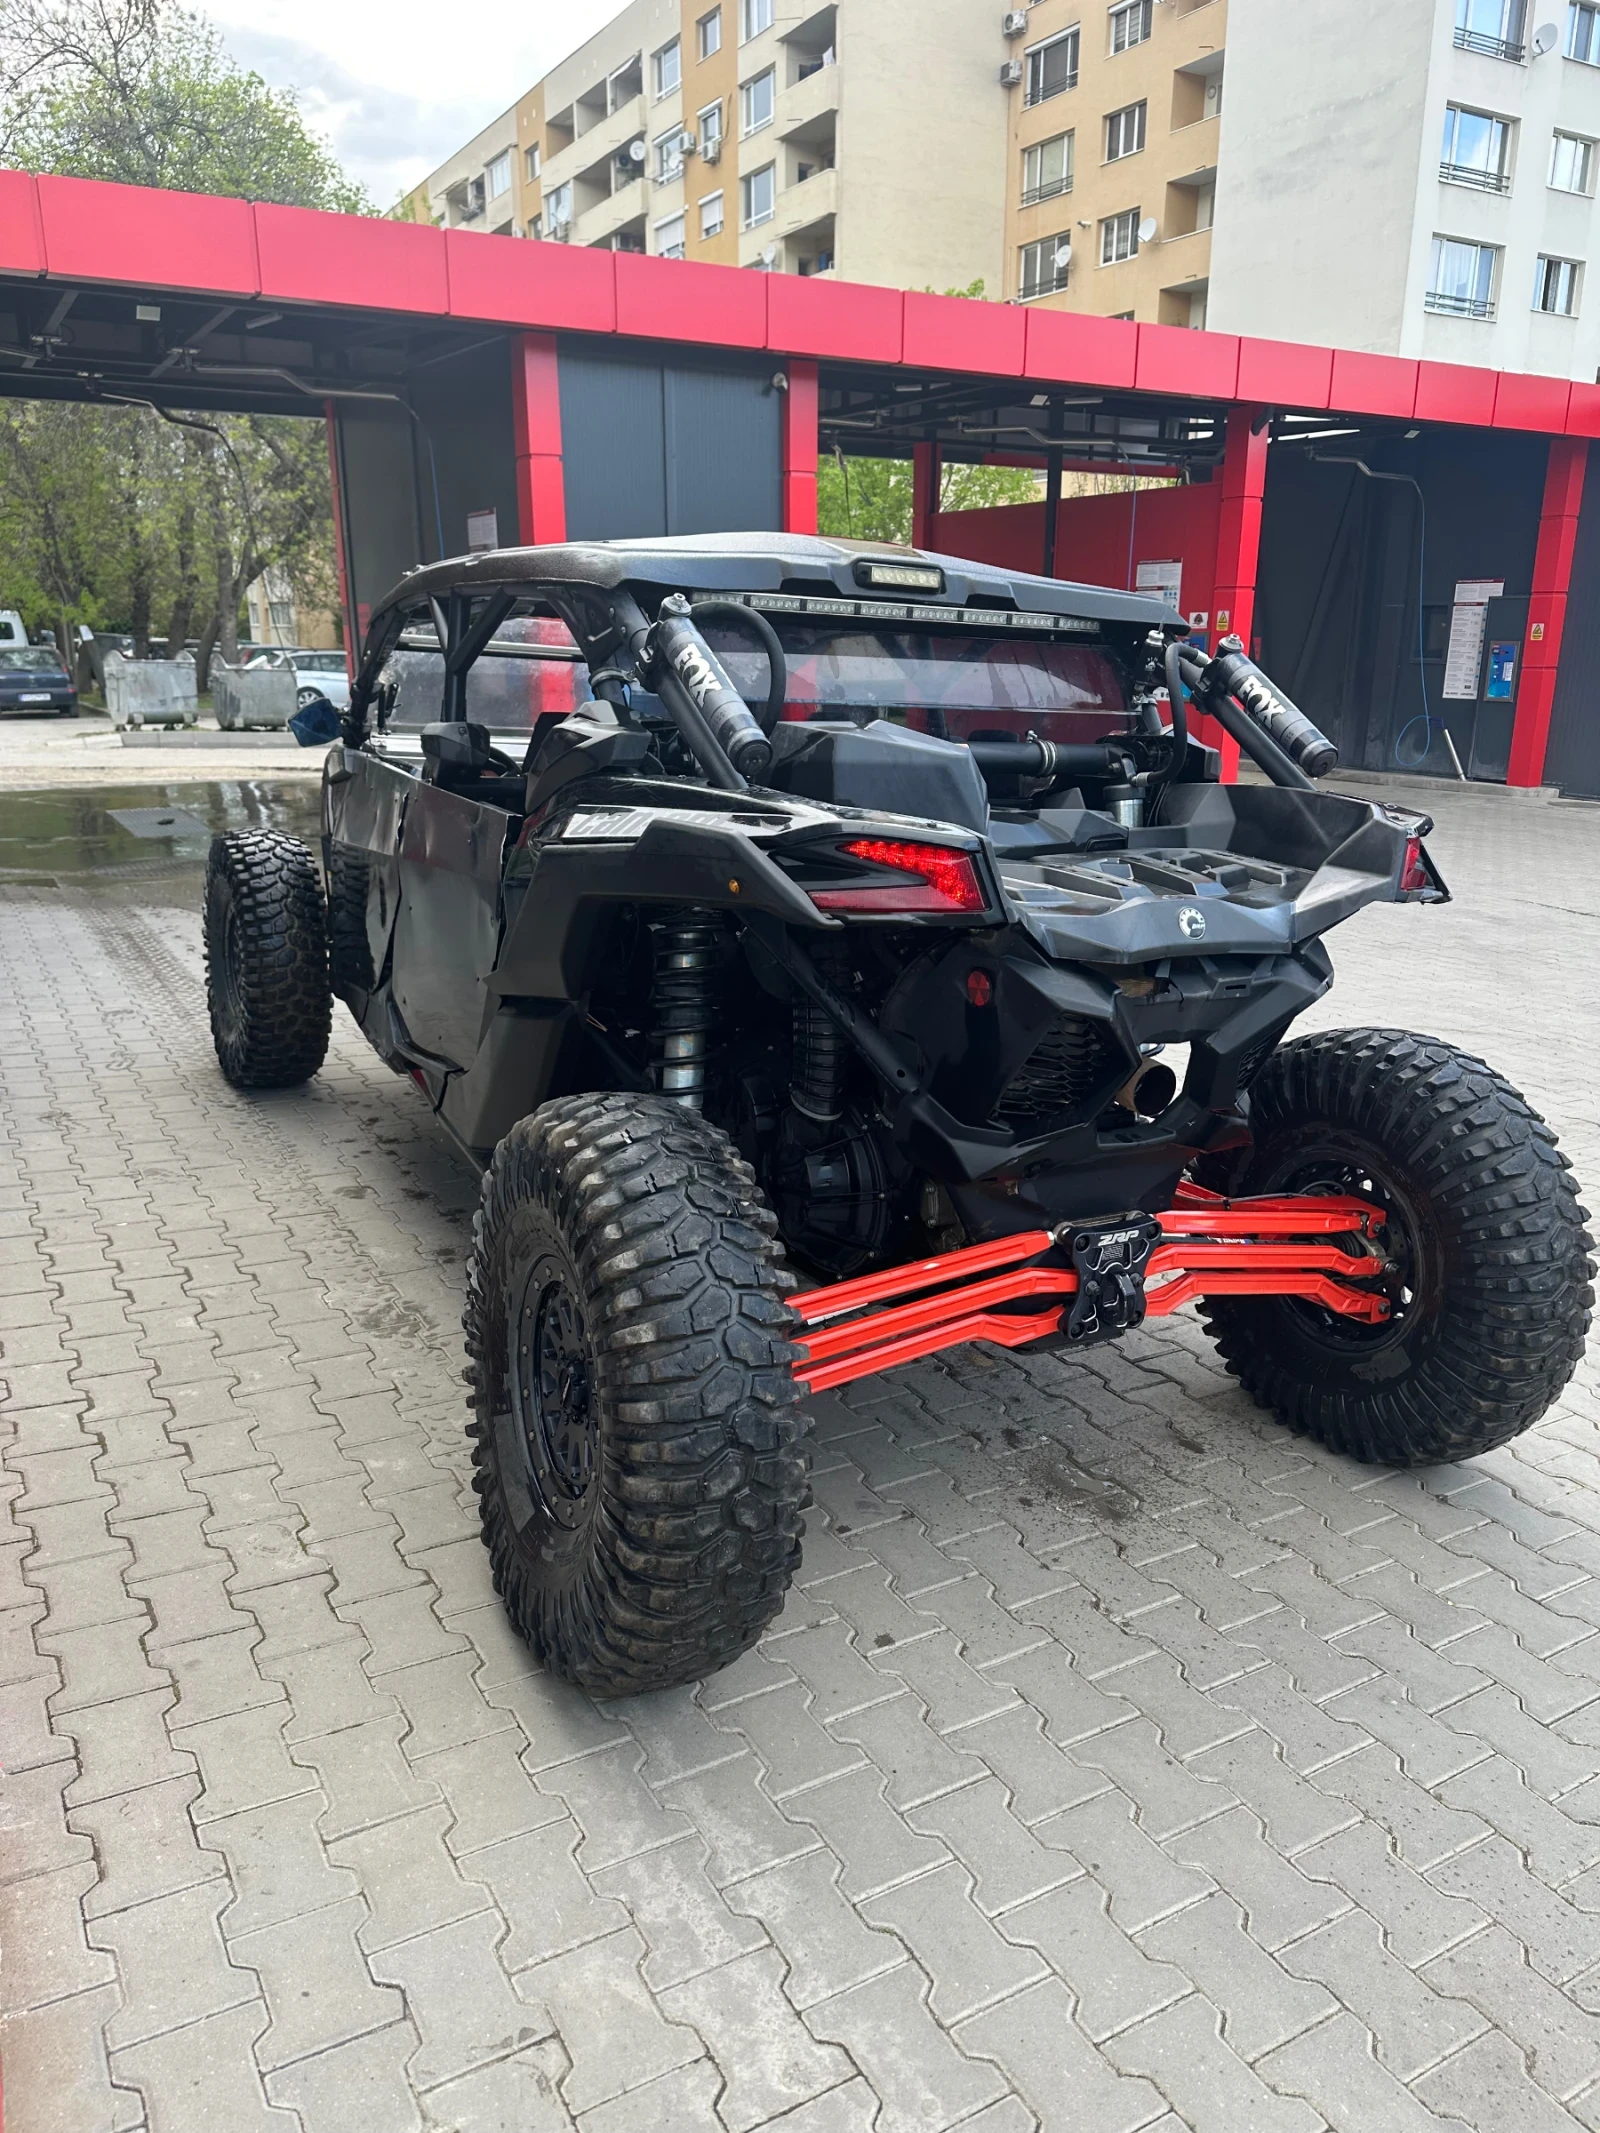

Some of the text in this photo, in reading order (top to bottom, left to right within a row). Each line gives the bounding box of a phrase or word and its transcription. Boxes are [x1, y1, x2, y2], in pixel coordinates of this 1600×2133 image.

[674, 642, 723, 709] FOX
[1237, 675, 1287, 730] FOX
[1097, 1229, 1140, 1247] ZRP
